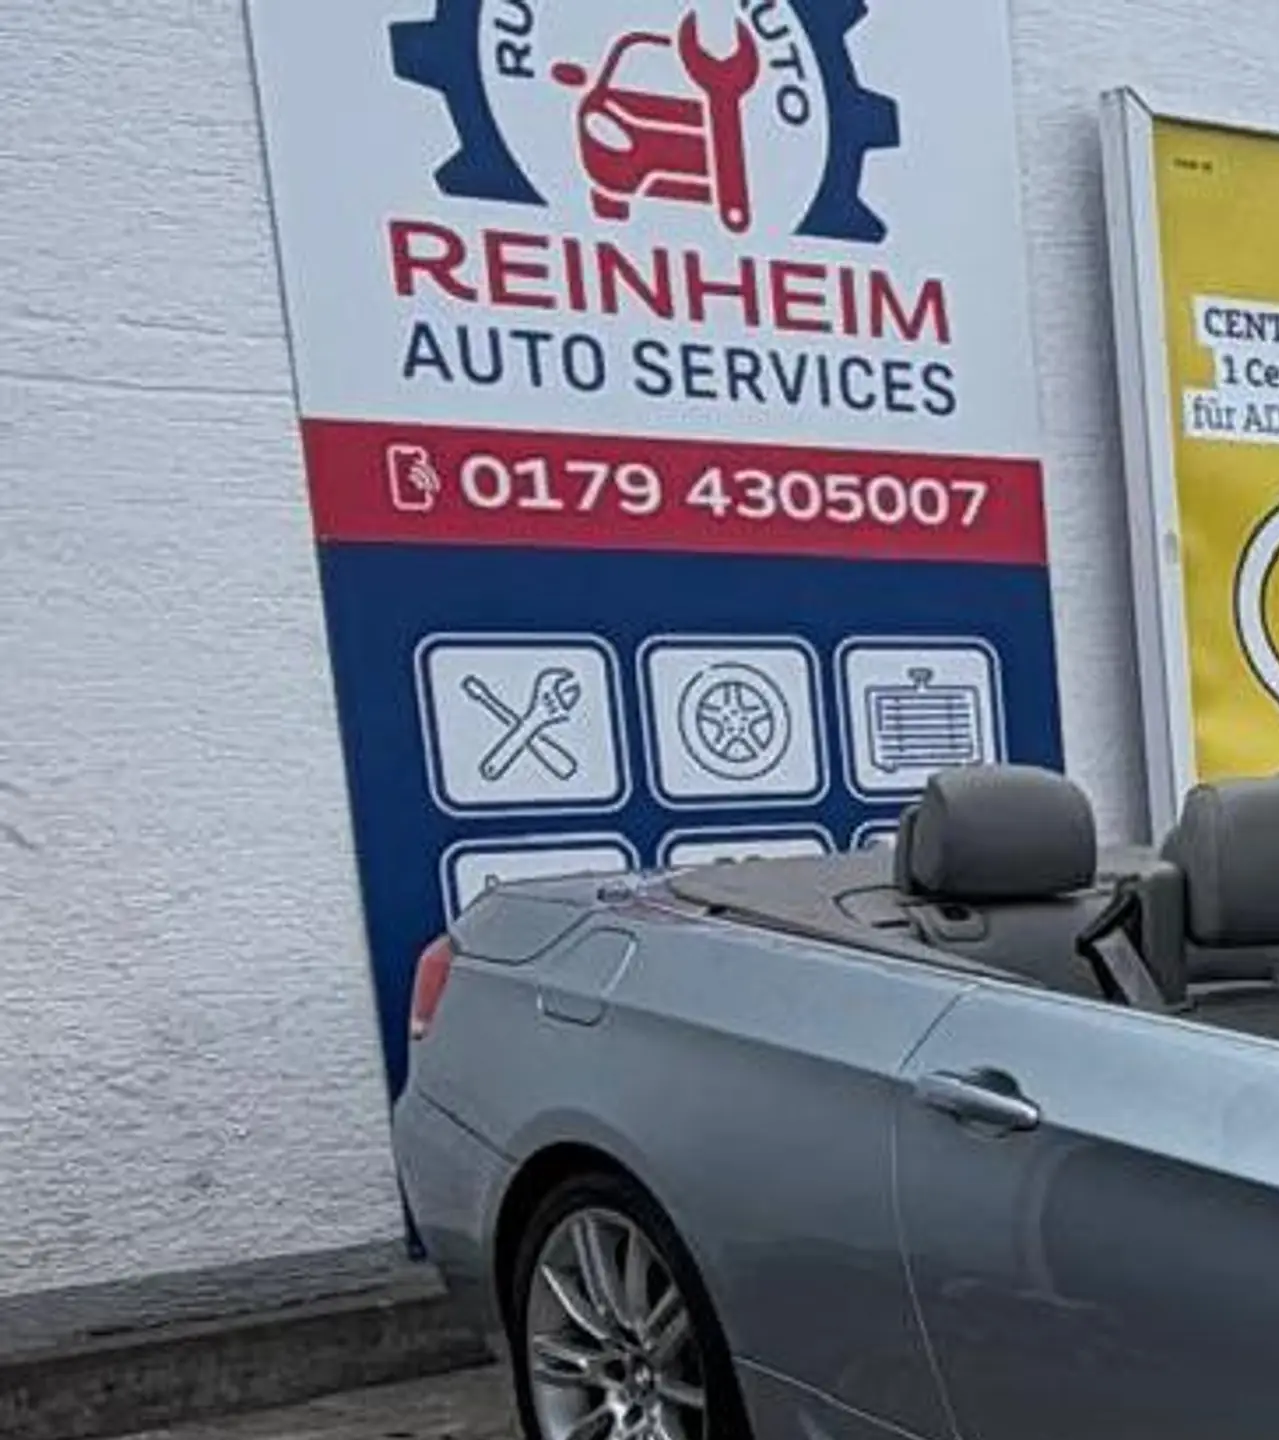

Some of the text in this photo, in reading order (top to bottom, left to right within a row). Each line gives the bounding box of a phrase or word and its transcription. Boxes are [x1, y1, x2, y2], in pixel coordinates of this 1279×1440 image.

[737, 0, 810, 126] UTO
[388, 219, 953, 344] REINHEIM
[402, 322, 957, 416] AUTO SERVICES
[1222, 355, 1238, 384] 1
[1193, 395, 1237, 430] für
[460, 455, 988, 527] 0179 4305007
